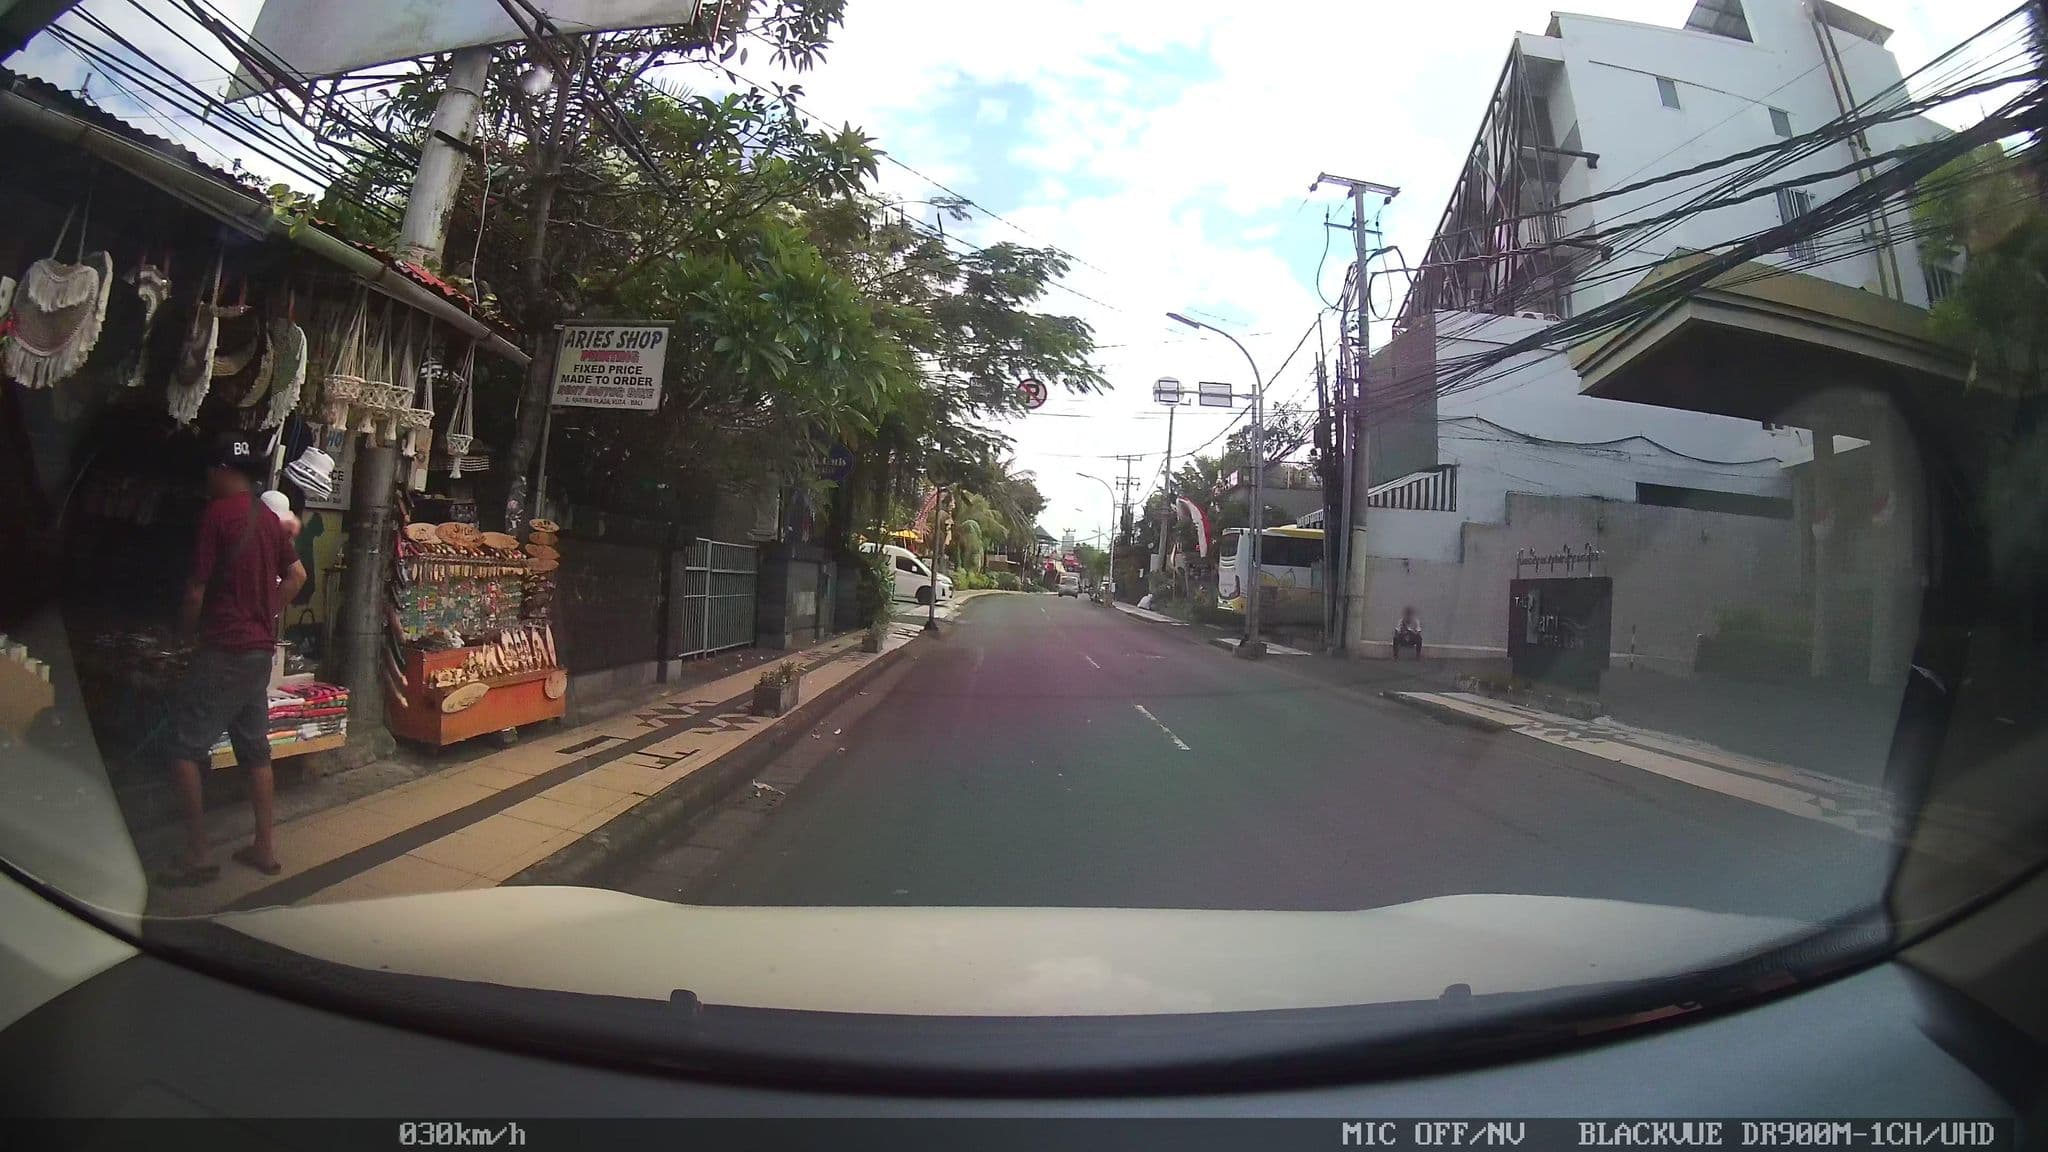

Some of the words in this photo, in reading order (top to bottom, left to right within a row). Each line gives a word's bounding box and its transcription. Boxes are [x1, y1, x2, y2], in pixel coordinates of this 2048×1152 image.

[564, 331, 614, 349] ARIES
[616, 331, 663, 350] SHOP
[574, 364, 605, 375] FIXED
[608, 365, 643, 375] PRICE
[561, 374, 594, 384] MADE
[596, 376, 610, 385] TO
[613, 377, 652, 387] ORDER
